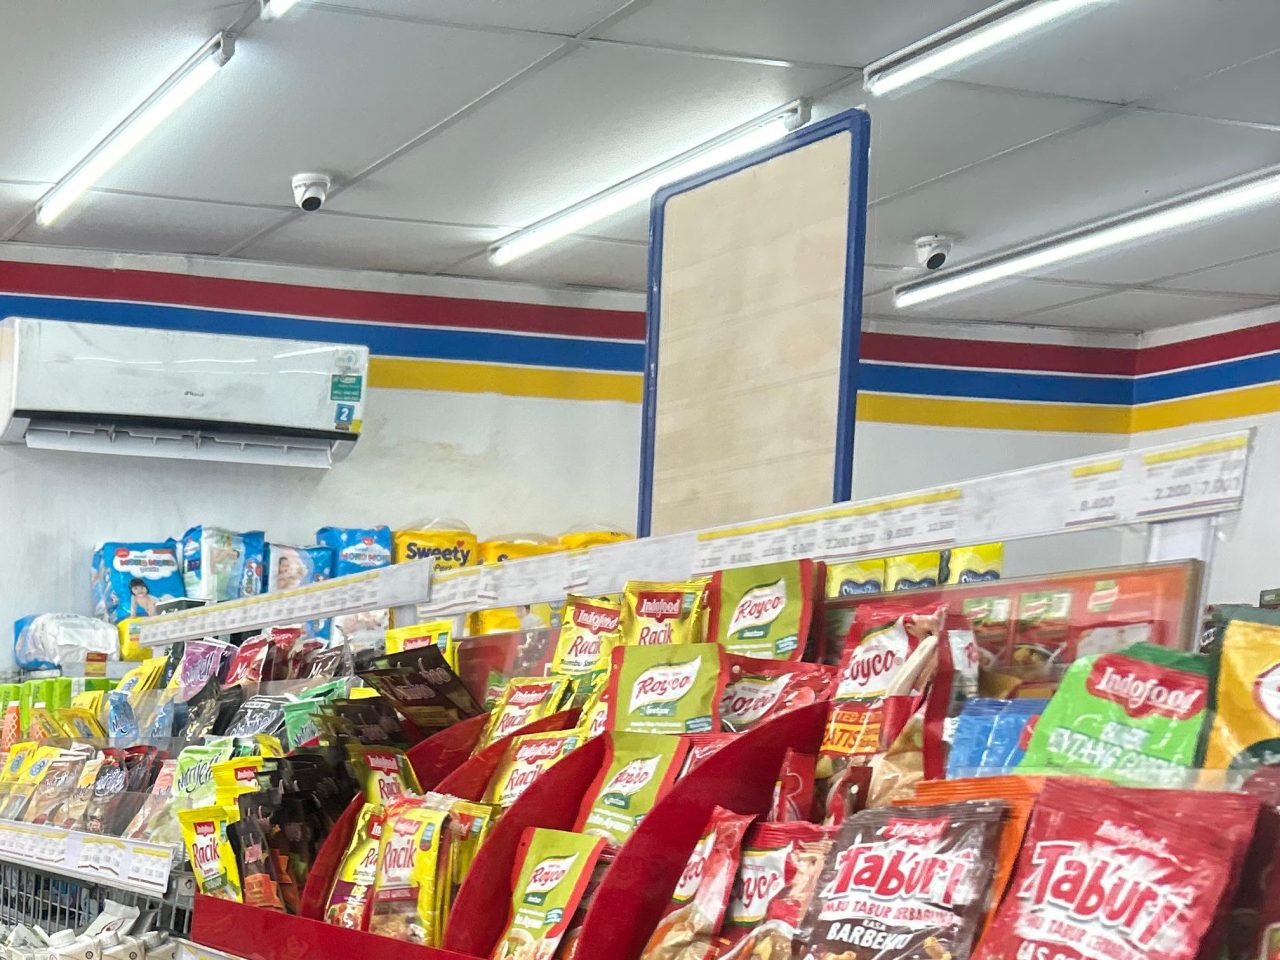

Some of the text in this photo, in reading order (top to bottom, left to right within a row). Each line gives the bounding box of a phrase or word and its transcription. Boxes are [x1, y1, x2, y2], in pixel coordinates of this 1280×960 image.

[340, 407, 349, 421] 2
[406, 543, 471, 565] Sweety
[639, 597, 681, 616] Indofood
[735, 594, 781, 622] Royco
[639, 622, 673, 645] Racik
[637, 672, 691, 698] Royco
[1095, 666, 1203, 714] Indofood
[191, 841, 221, 870] Racik
[381, 839, 418, 874] Racik
[851, 900, 891, 917] TABUR
